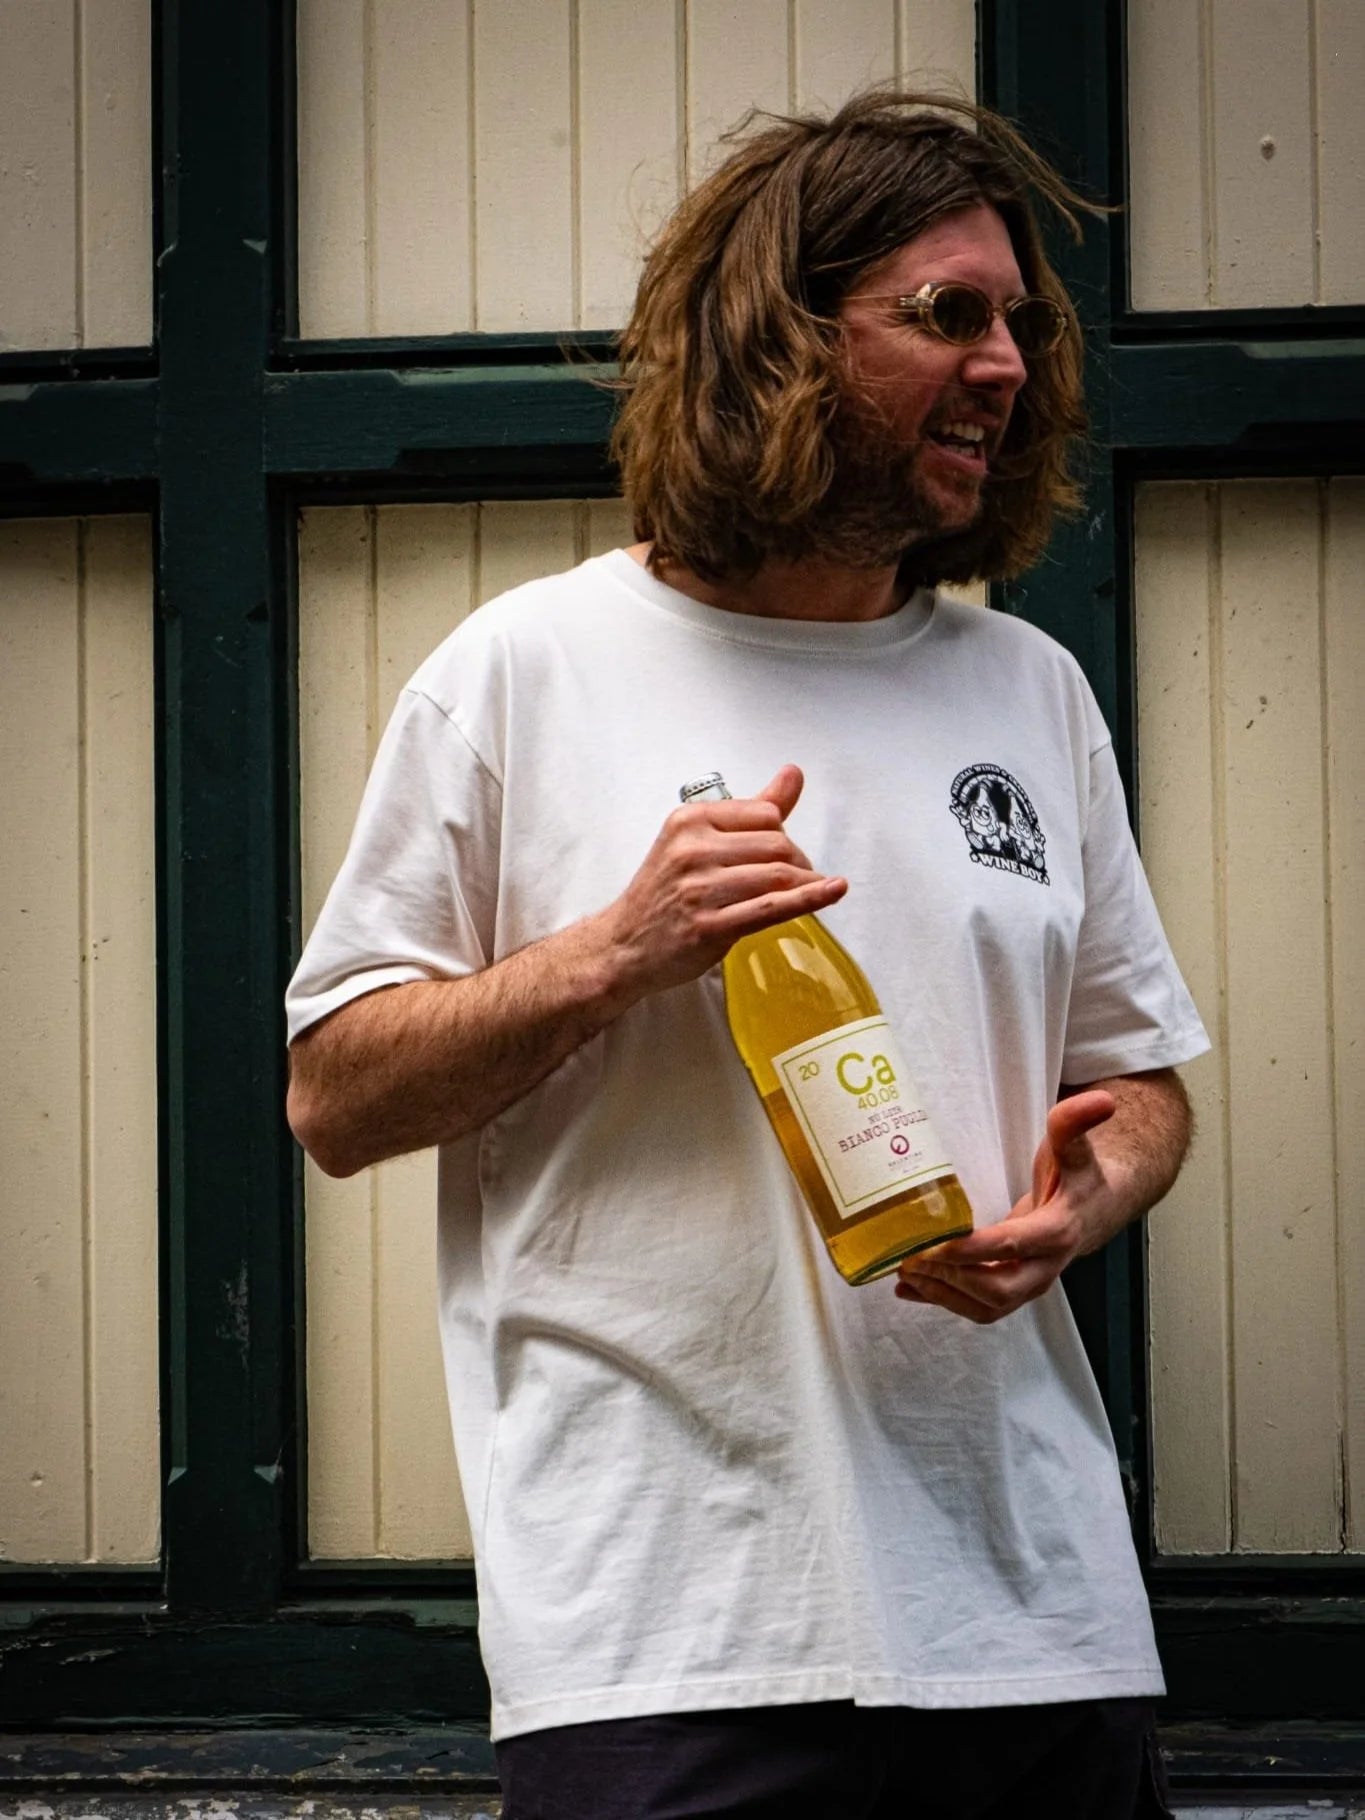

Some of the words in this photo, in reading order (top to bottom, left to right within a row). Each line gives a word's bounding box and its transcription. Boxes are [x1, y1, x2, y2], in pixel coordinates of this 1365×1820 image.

[973, 765, 1000, 773] WINES
[978, 852, 1019, 874] WINE
[1019, 863, 1044, 884] BOY
[798, 1061, 820, 1081] 20
[836, 1052, 897, 1096] Ca
[857, 1085, 899, 1110] 40.08
[838, 1122, 890, 1153] BIANCO
